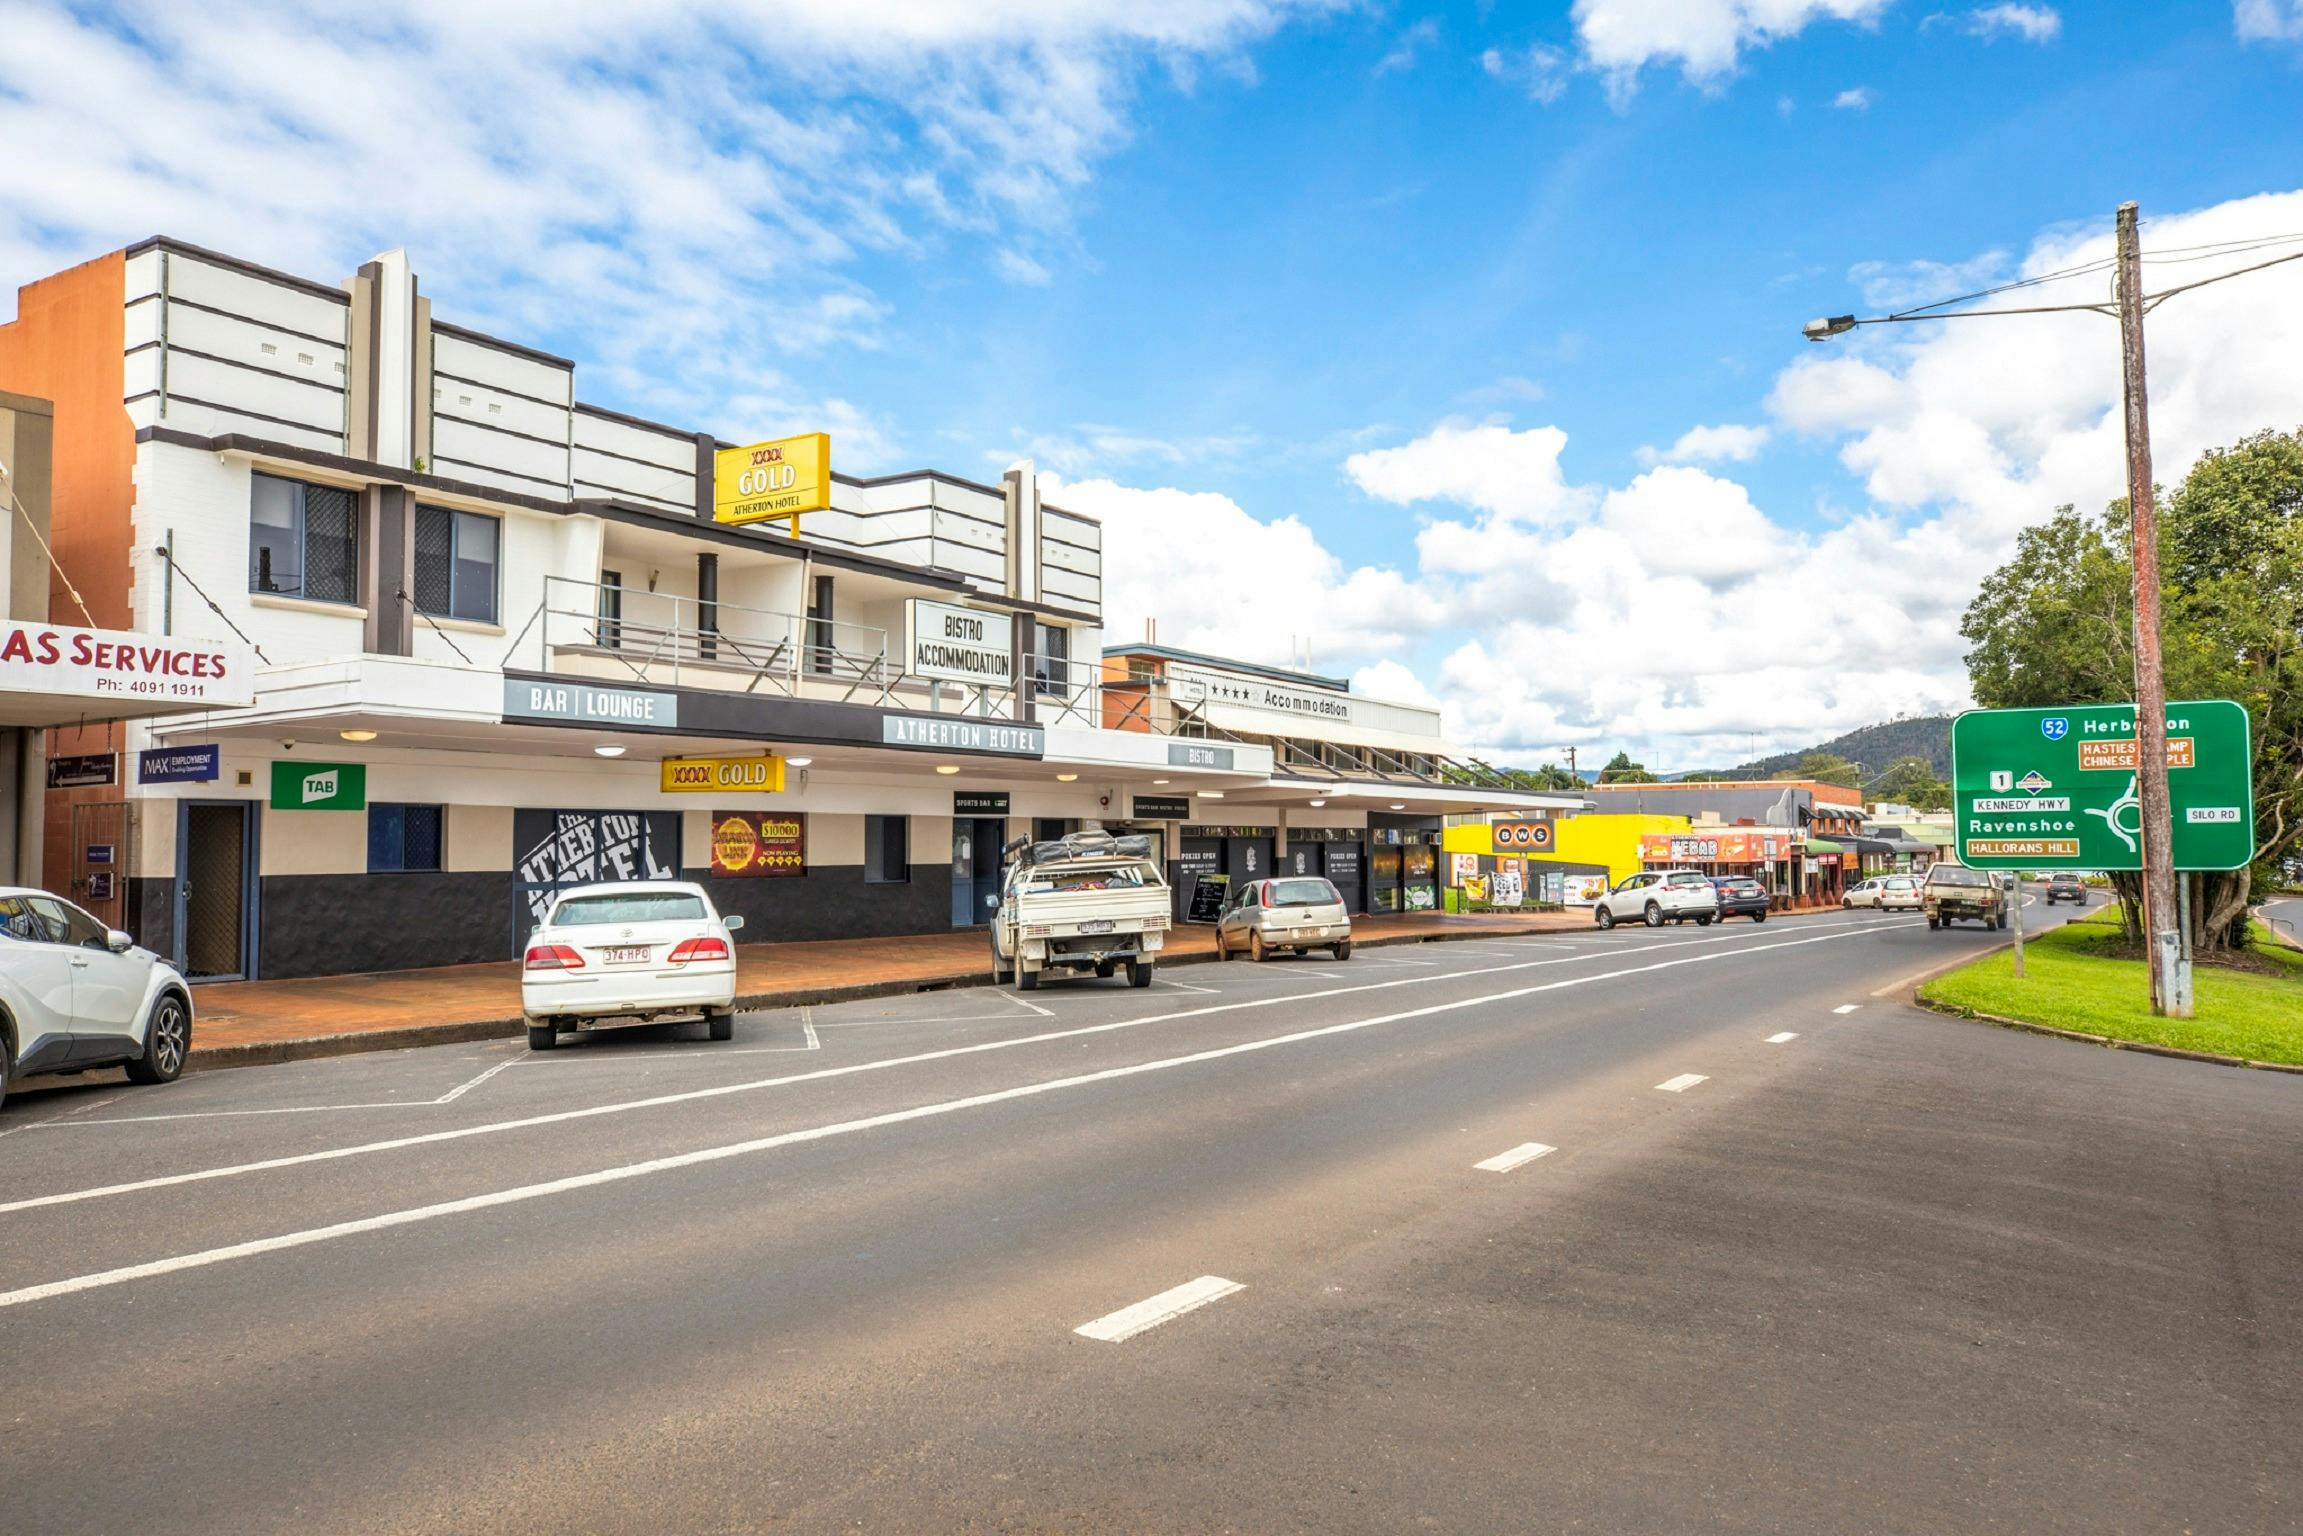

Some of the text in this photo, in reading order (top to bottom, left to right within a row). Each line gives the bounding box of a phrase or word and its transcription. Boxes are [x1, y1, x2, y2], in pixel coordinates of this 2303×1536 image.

[751, 447, 783, 466] XXXX
[739, 464, 796, 495] GOLD
[733, 496, 801, 516] ATHERTON HOTEL
[945, 615, 983, 642] BISTRO
[70, 633, 227, 679] SERVICES
[917, 643, 1009, 676] ACCOMMODATION
[97, 678, 204, 696] Ph: 4091 1911
[530, 687, 655, 720] BAR LOUNGE
[1264, 689, 1348, 717] Accommodation
[896, 720, 1036, 751] ATHERTON HOTEL
[2045, 720, 2064, 735] 52
[1189, 748, 1215, 765] BISTRO
[2083, 743, 2136, 755] HASTIES
[144, 758, 169, 775] MAX
[171, 754, 212, 766] EMPLOYMENT
[2083, 756, 2135, 767] CHINESE
[674, 763, 767, 785] XXXX GOLD
[1998, 775, 2004, 786] 1
[306, 780, 334, 793] TAB
[1977, 799, 2065, 810] KENNEDY HWY
[2192, 810, 2235, 820] SILO RD
[1969, 819, 2076, 832] Ravenshoe
[1971, 842, 2075, 853] HALLORANS HILL
